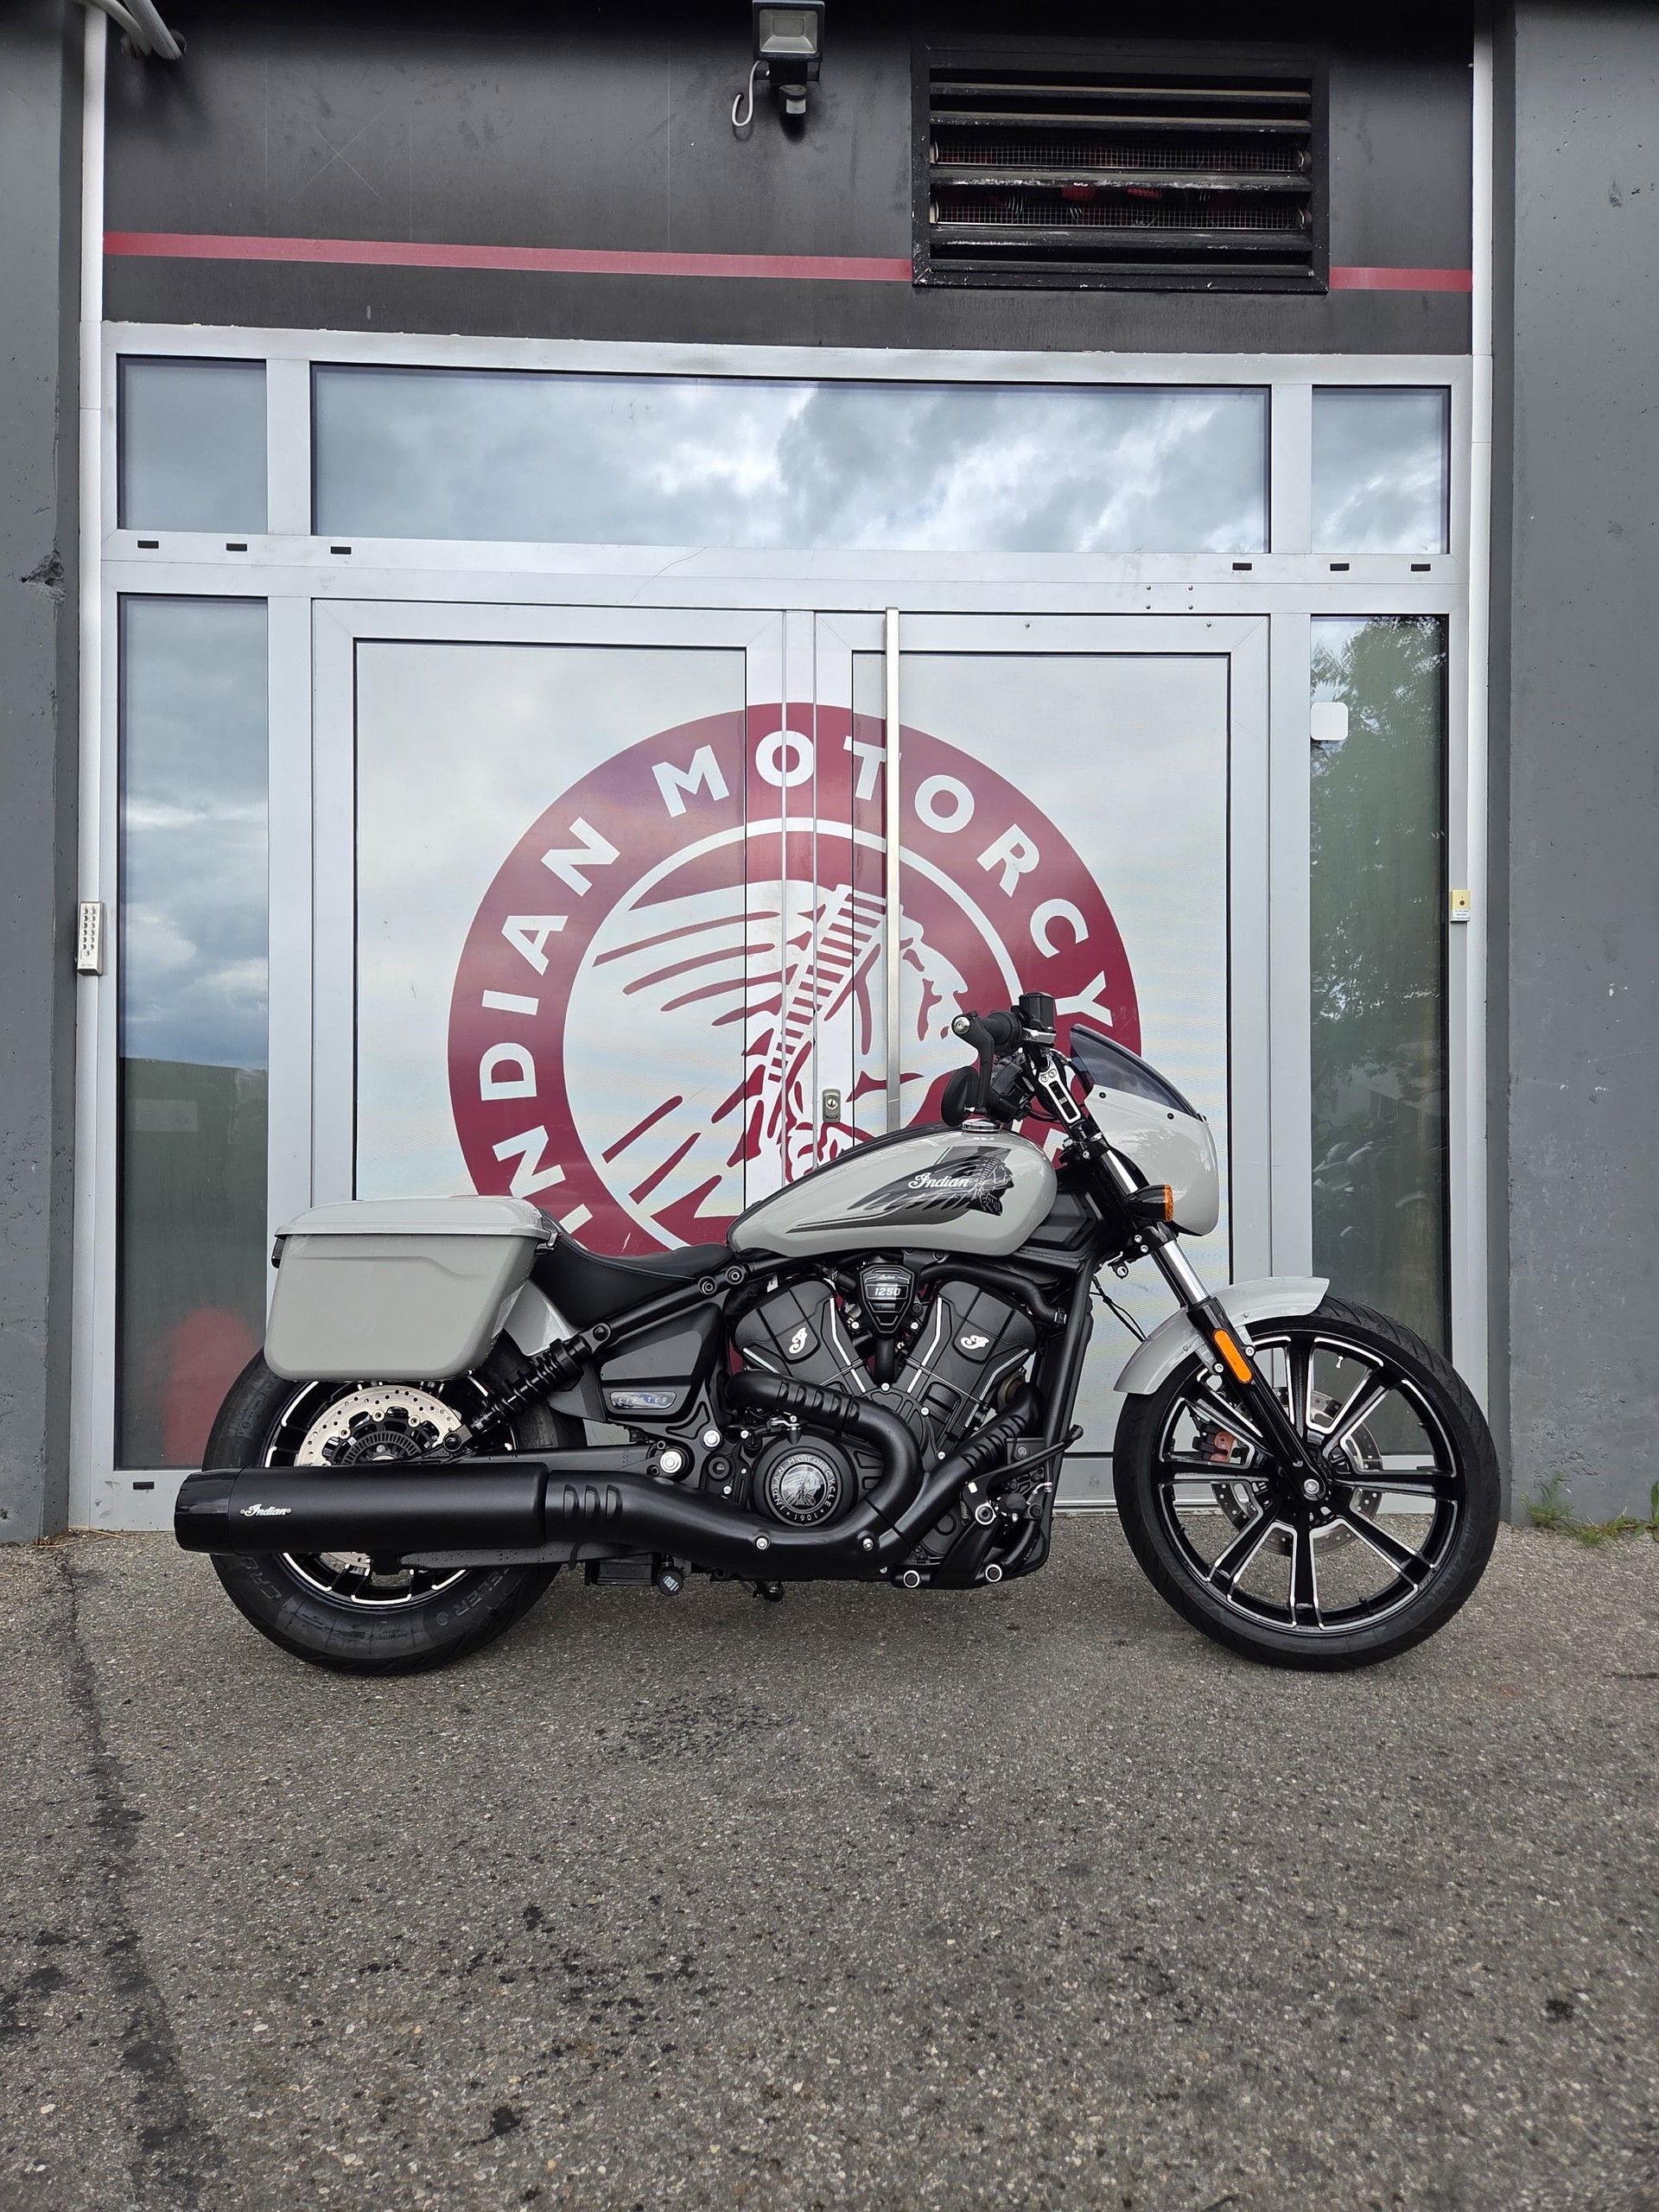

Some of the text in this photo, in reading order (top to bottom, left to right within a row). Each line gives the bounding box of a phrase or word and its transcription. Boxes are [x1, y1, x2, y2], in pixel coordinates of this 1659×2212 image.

[652, 730, 1113, 1162] MOTORCY
[908, 1173, 969, 1189] Indian
[874, 1287, 901, 1296] 1250
[772, 1454, 836, 1510] INDIAN MOTORCYCLE
[243, 1503, 289, 1517] Indian
